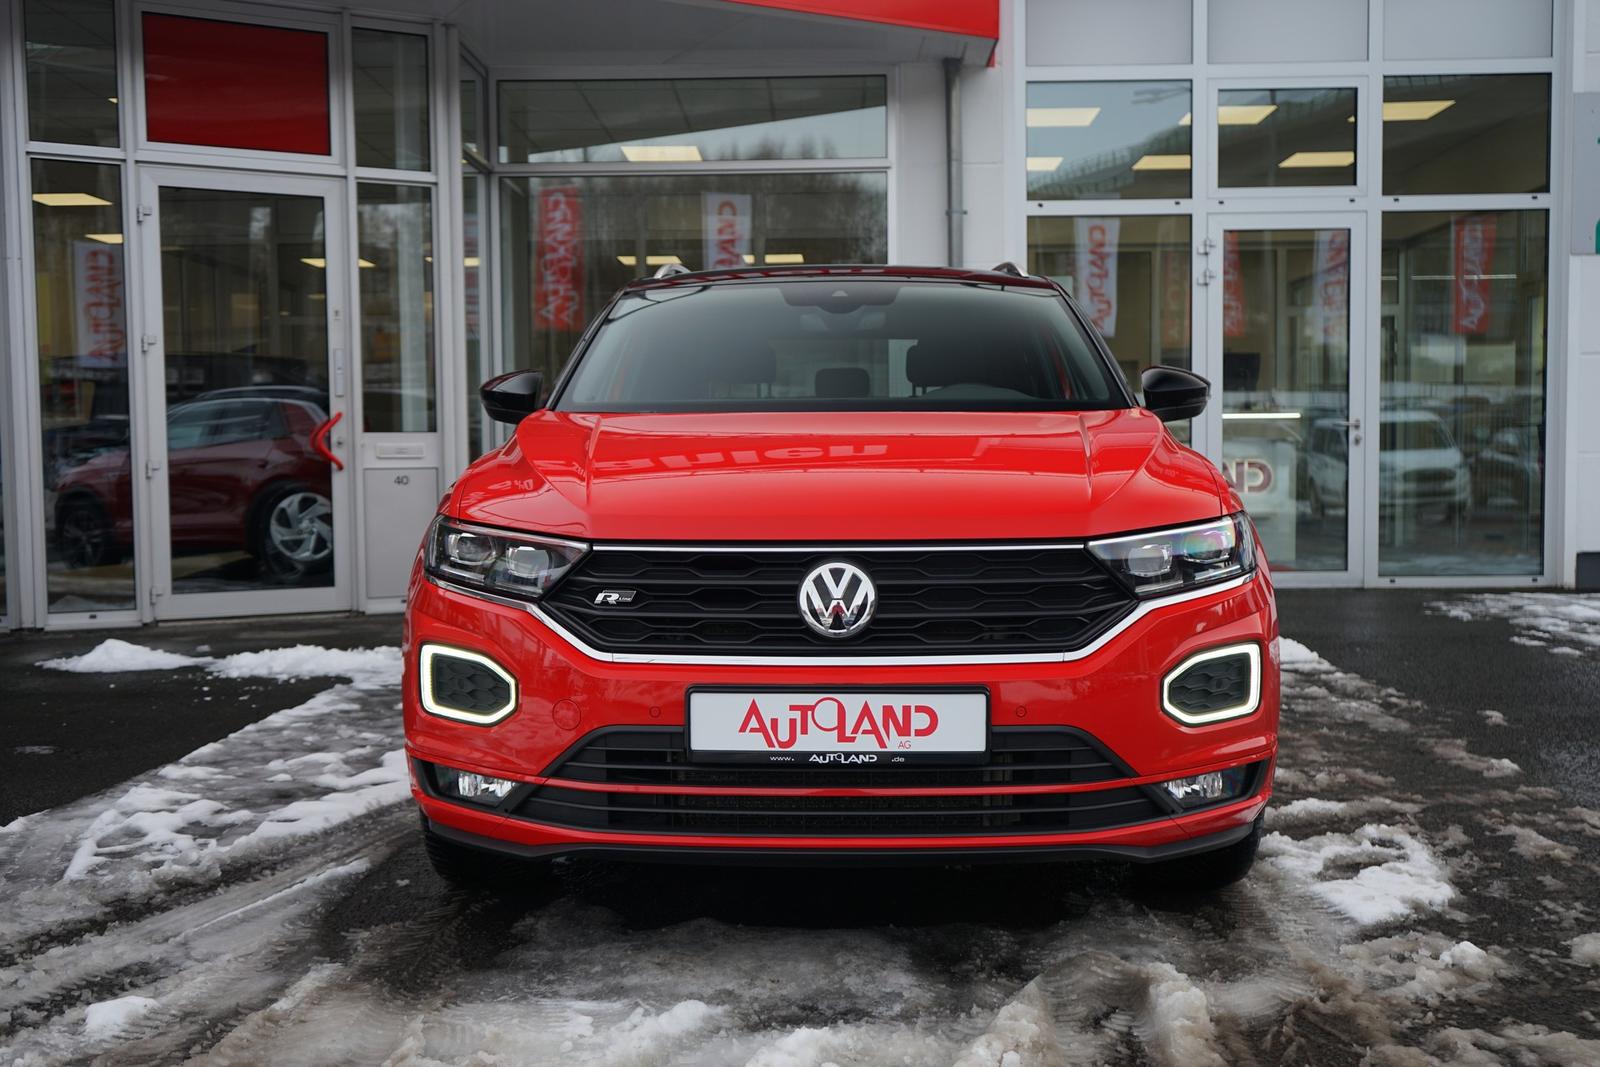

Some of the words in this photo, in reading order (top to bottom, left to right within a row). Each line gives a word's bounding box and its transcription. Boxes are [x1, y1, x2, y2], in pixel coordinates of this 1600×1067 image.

[394, 475, 409, 485] 40
[738, 697, 938, 749] AUTOLAND
[897, 740, 912, 749] AG
[808, 752, 878, 764] AUTOLAND
